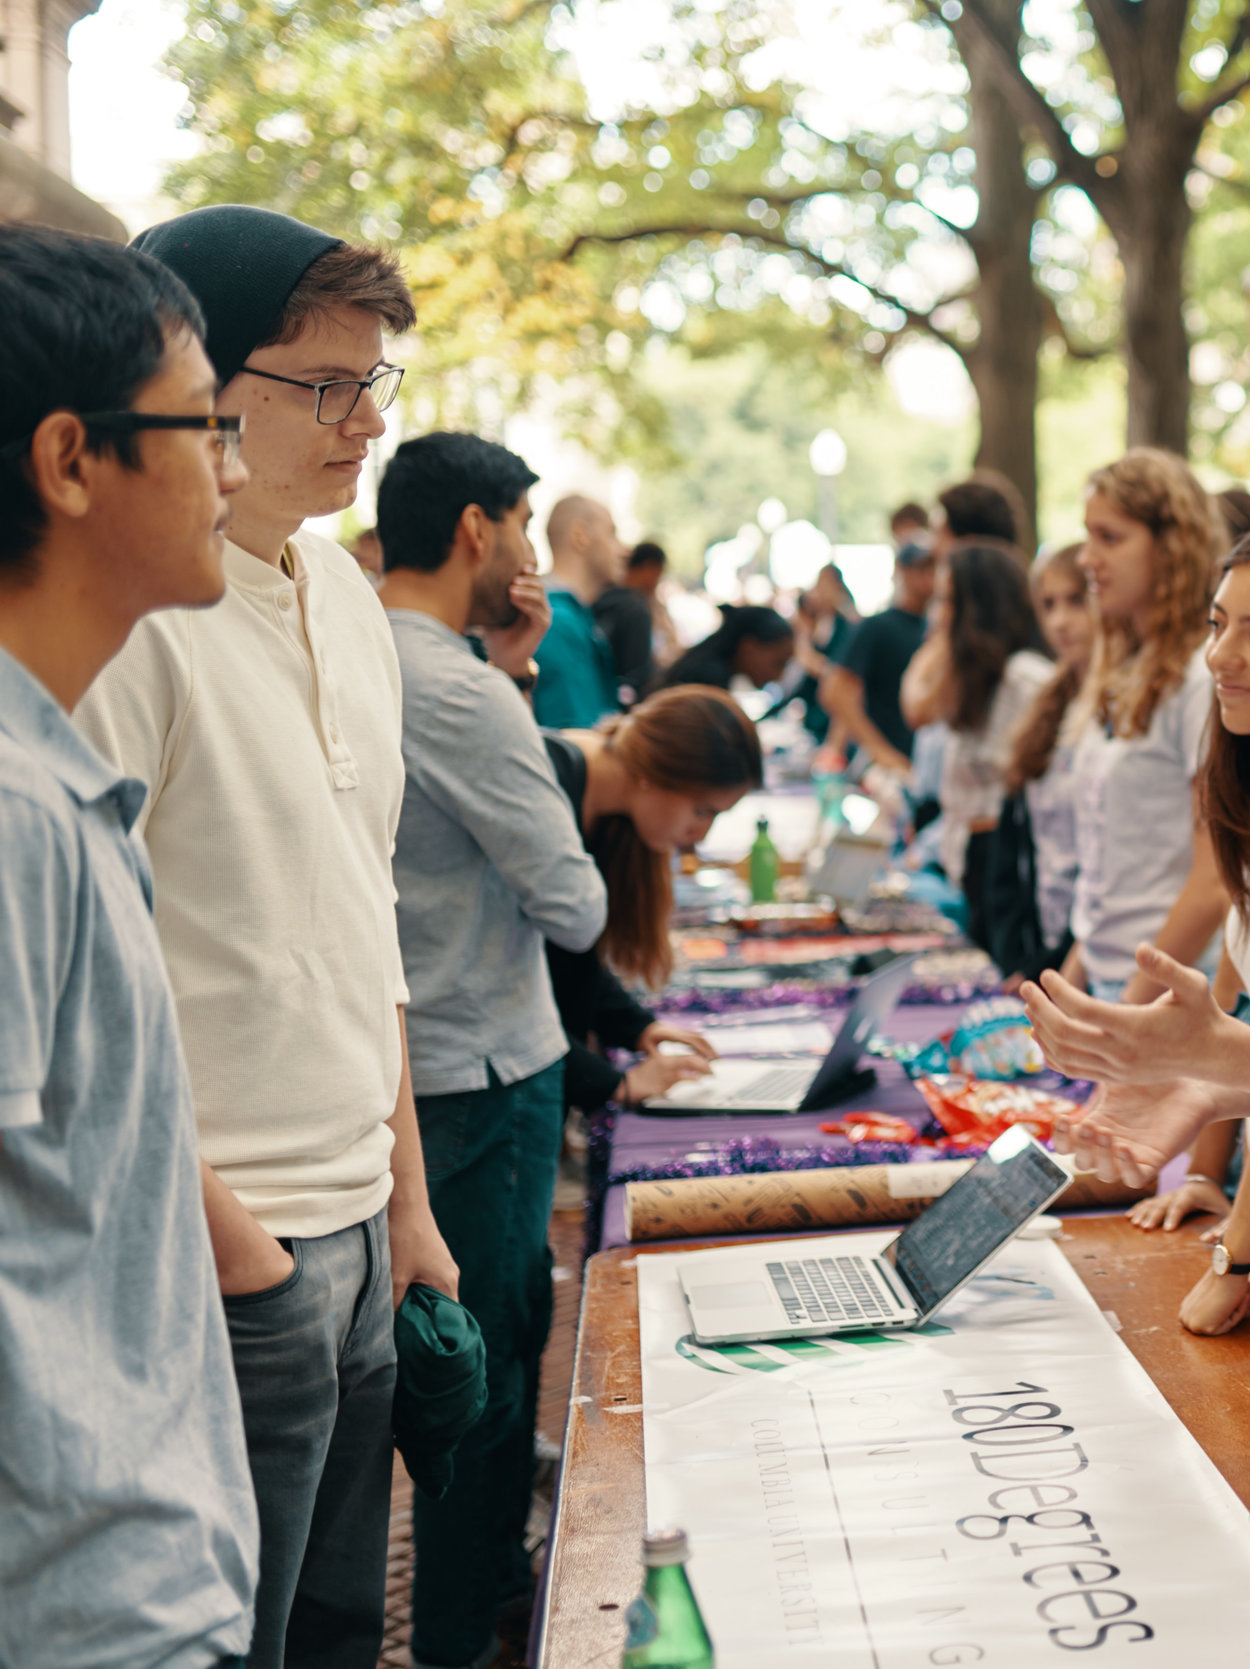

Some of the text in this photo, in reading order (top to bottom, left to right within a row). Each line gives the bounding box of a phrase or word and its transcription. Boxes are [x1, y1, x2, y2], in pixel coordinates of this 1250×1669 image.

[750, 1418, 825, 1648] COLUMBIA UNIVERSITY
[850, 1392, 985, 1666] CONSULTING
[943, 1381, 1155, 1651] 180Degrees
